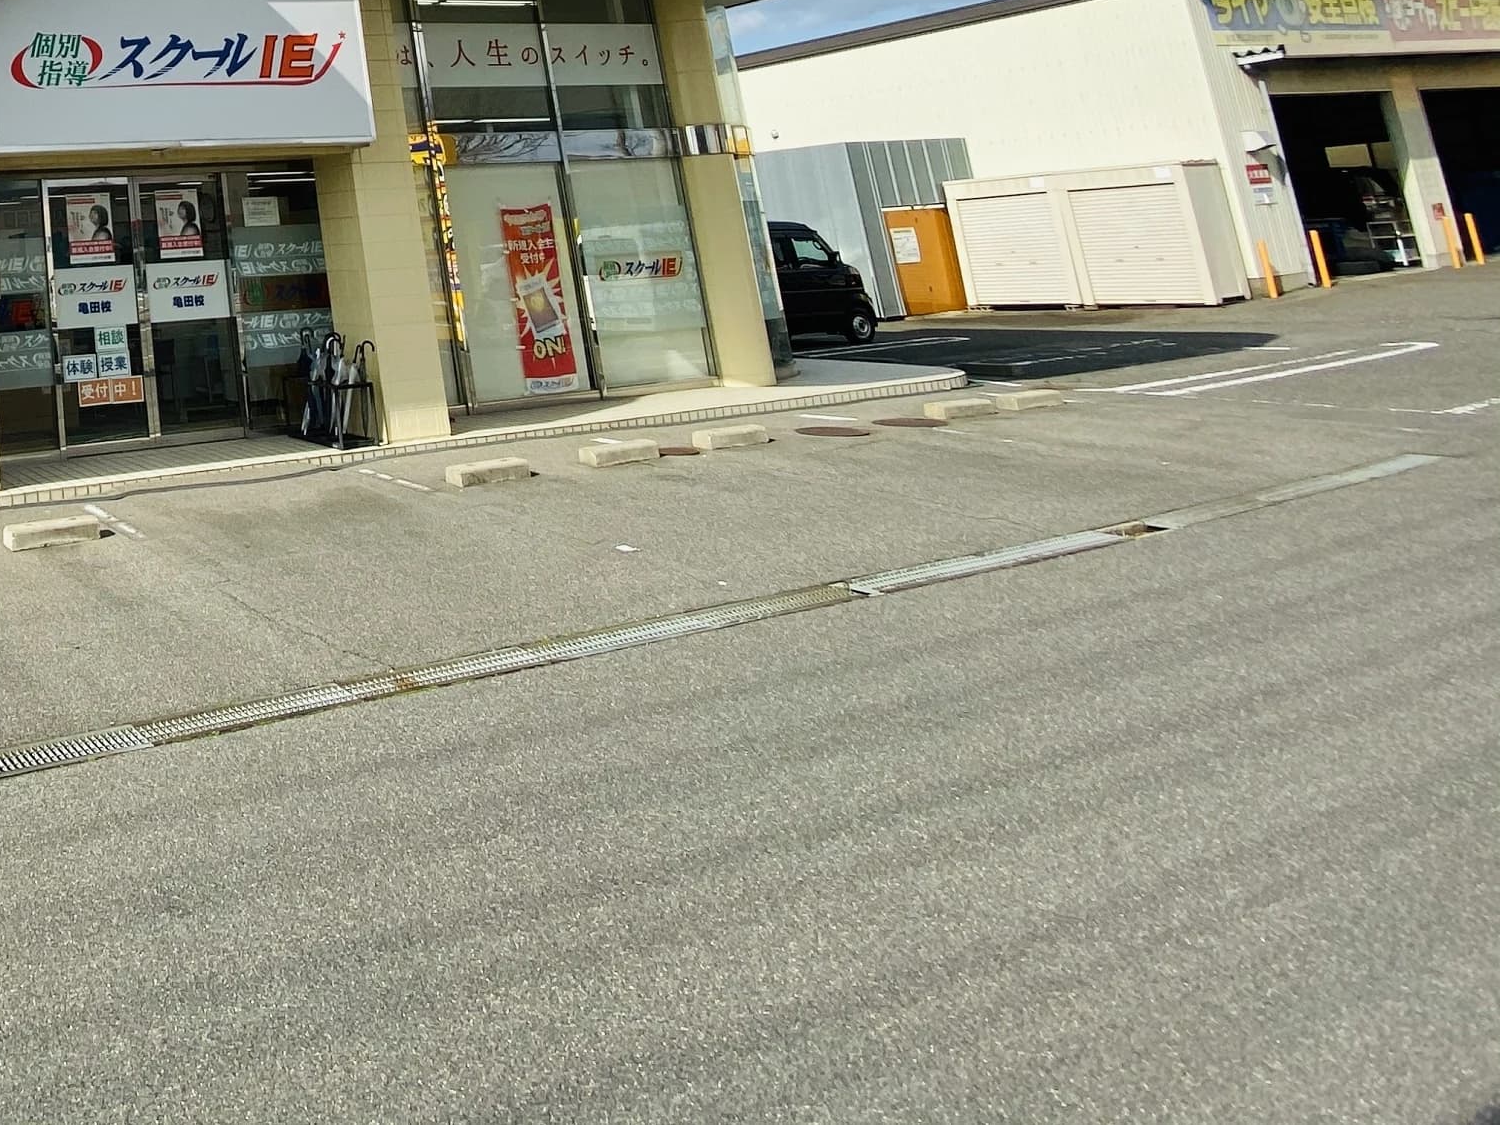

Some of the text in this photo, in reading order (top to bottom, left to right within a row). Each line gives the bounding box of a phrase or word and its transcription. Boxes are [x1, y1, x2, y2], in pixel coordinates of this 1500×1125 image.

[29, 31, 83, 59] 個別
[99, 32, 318, 81] スクールIE
[36, 60, 90, 87] 指導
[78, 300, 112, 315] 亀田校
[172, 294, 205, 309] 亀田校
[98, 329, 125, 346] 相談
[66, 359, 94, 376] 体験
[100, 356, 128, 373] 授業
